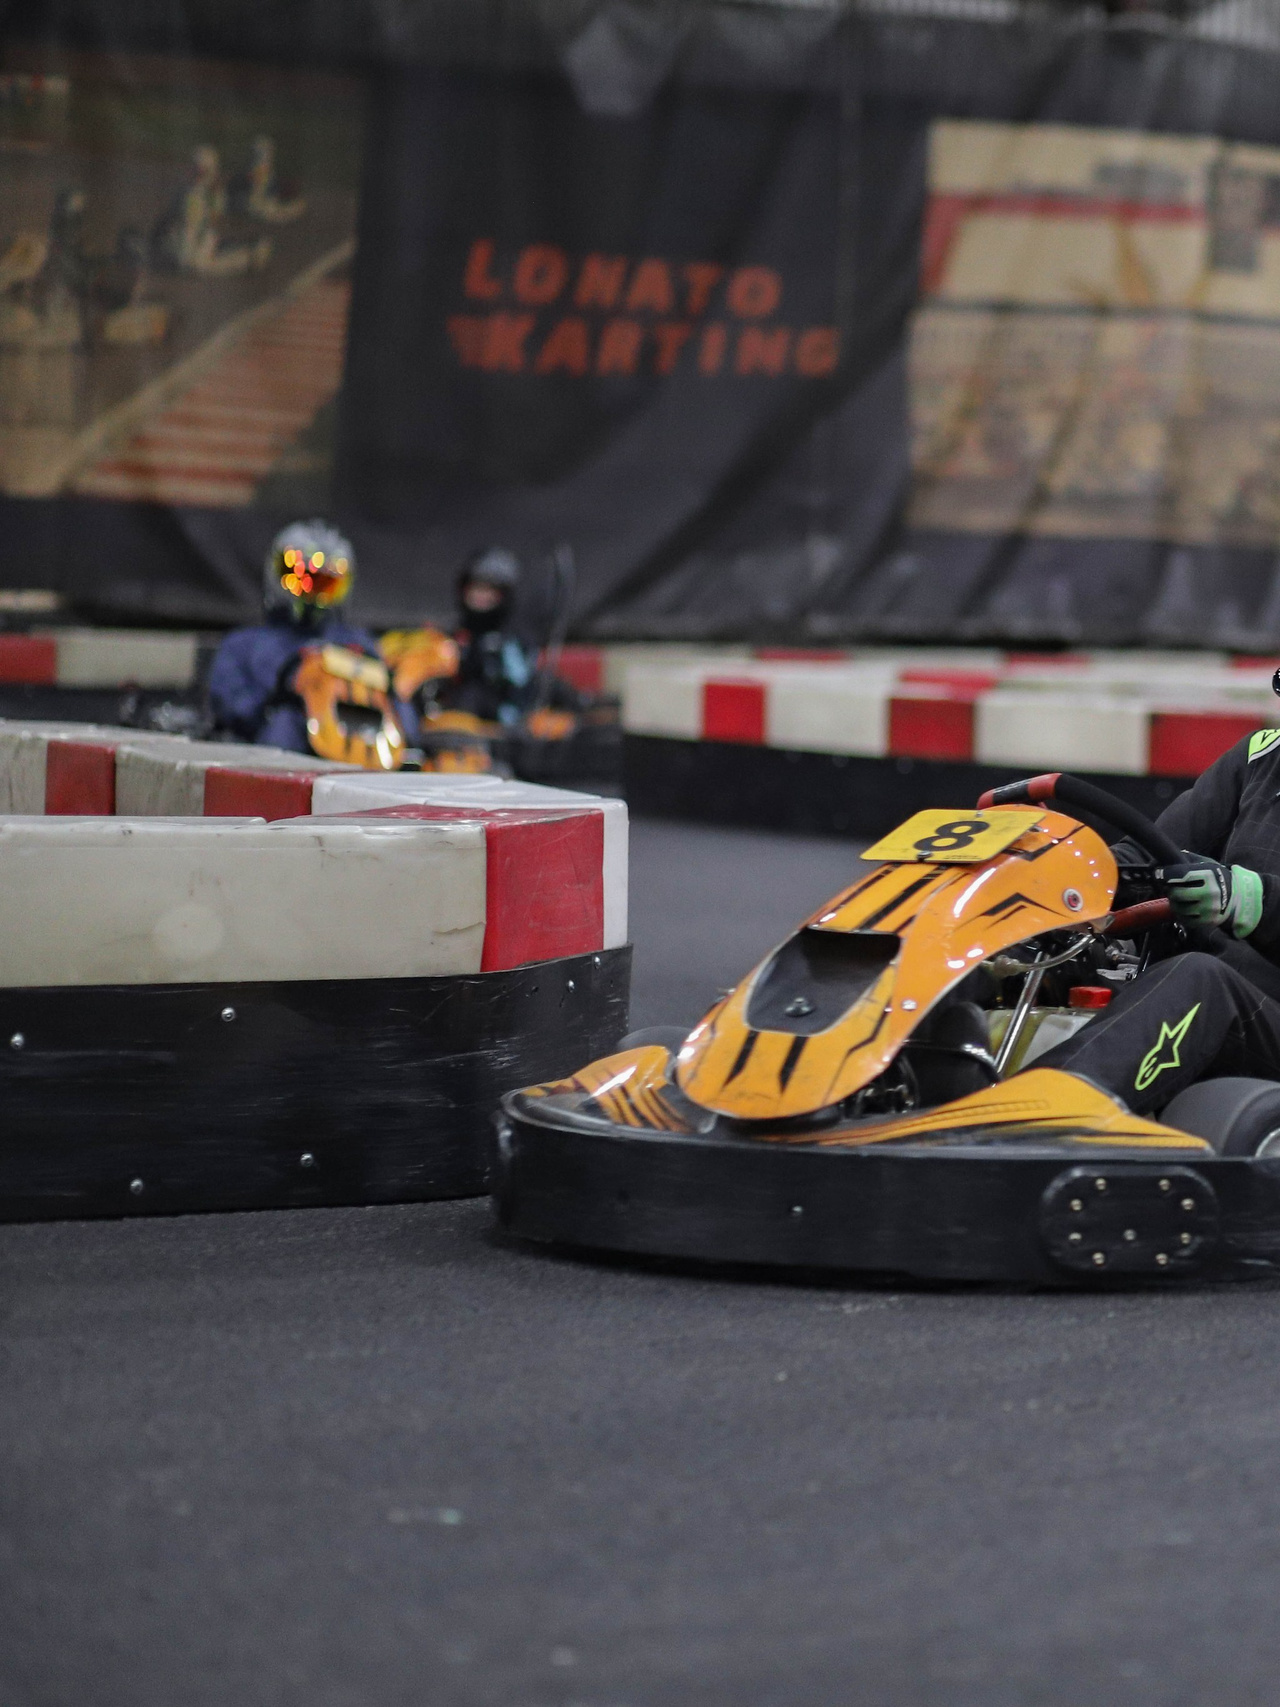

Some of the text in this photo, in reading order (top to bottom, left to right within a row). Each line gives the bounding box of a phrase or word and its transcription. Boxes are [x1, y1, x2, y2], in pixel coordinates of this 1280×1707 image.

[464, 238, 782, 318] LONATO
[446, 310, 840, 378] KARTING
[913, 820, 990, 852] 8
